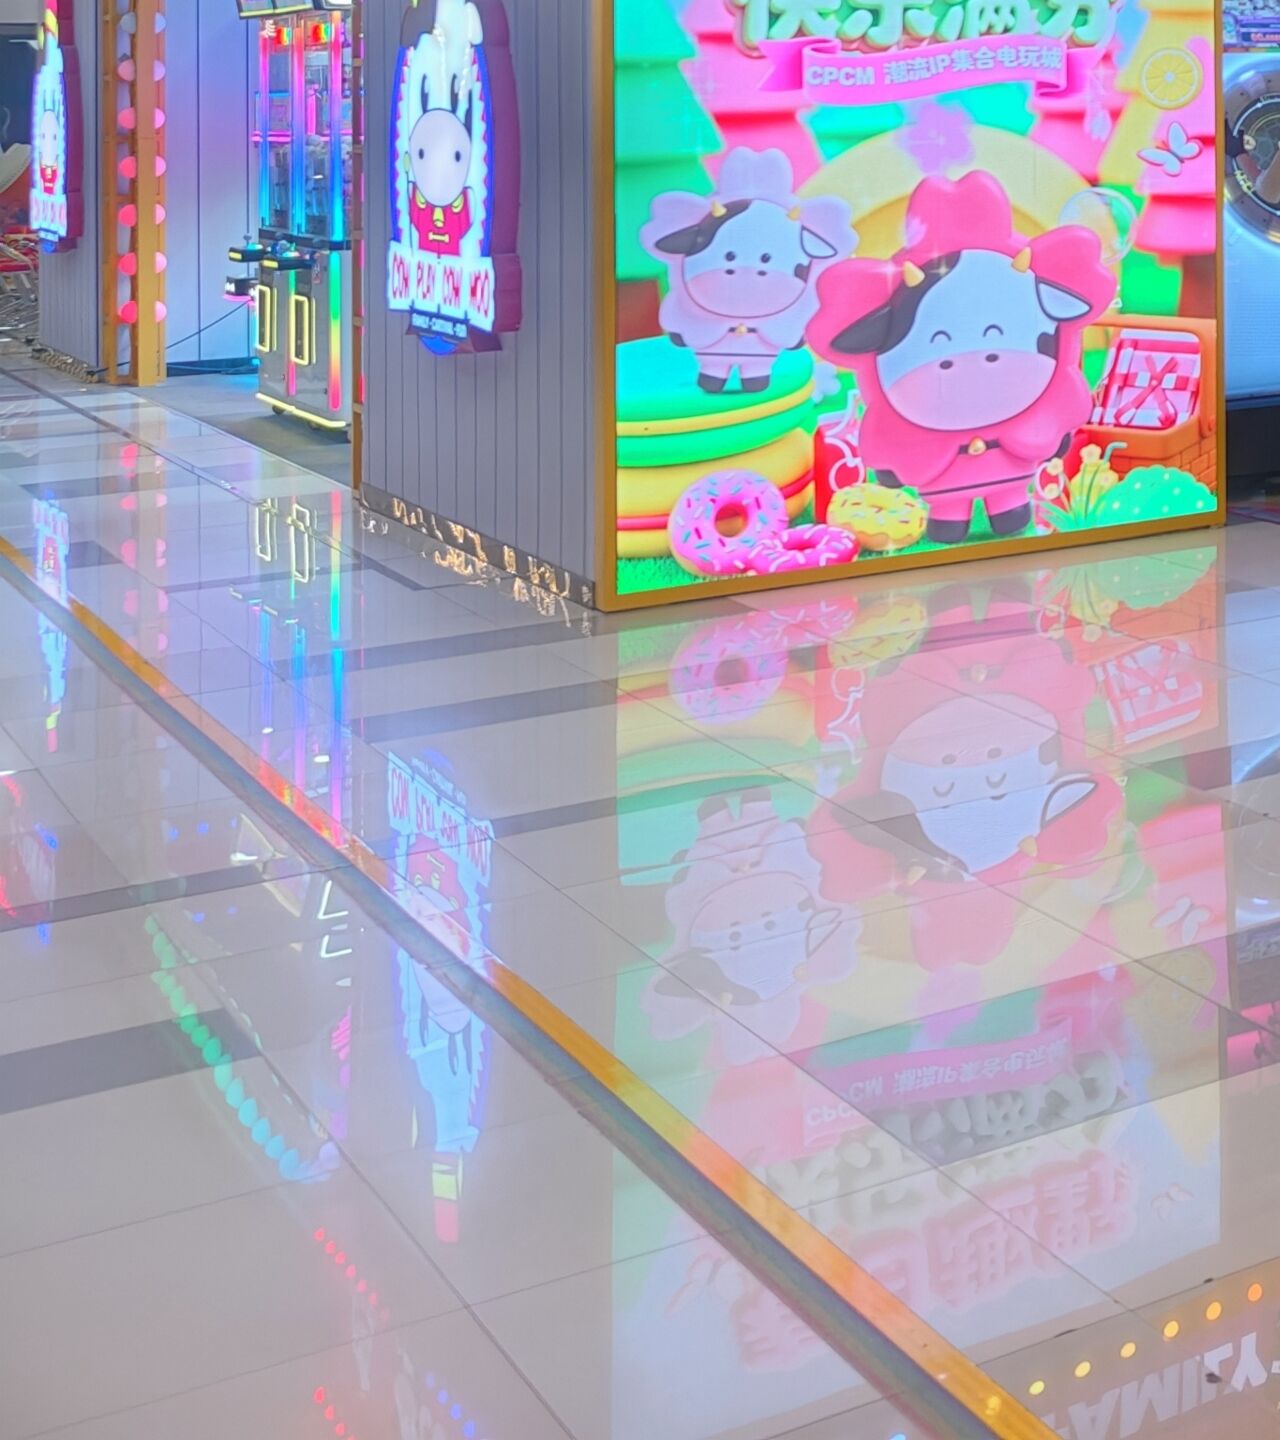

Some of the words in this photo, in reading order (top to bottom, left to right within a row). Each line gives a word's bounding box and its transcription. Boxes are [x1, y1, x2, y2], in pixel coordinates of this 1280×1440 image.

[806, 64, 874, 85] CPCM
[884, 46, 1063, 84] 潮流IP集合电玩城
[393, 251, 409, 300] COW
[416, 259, 435, 302] PLAY
[443, 264, 462, 309] COW
[469, 268, 490, 318] MOO
